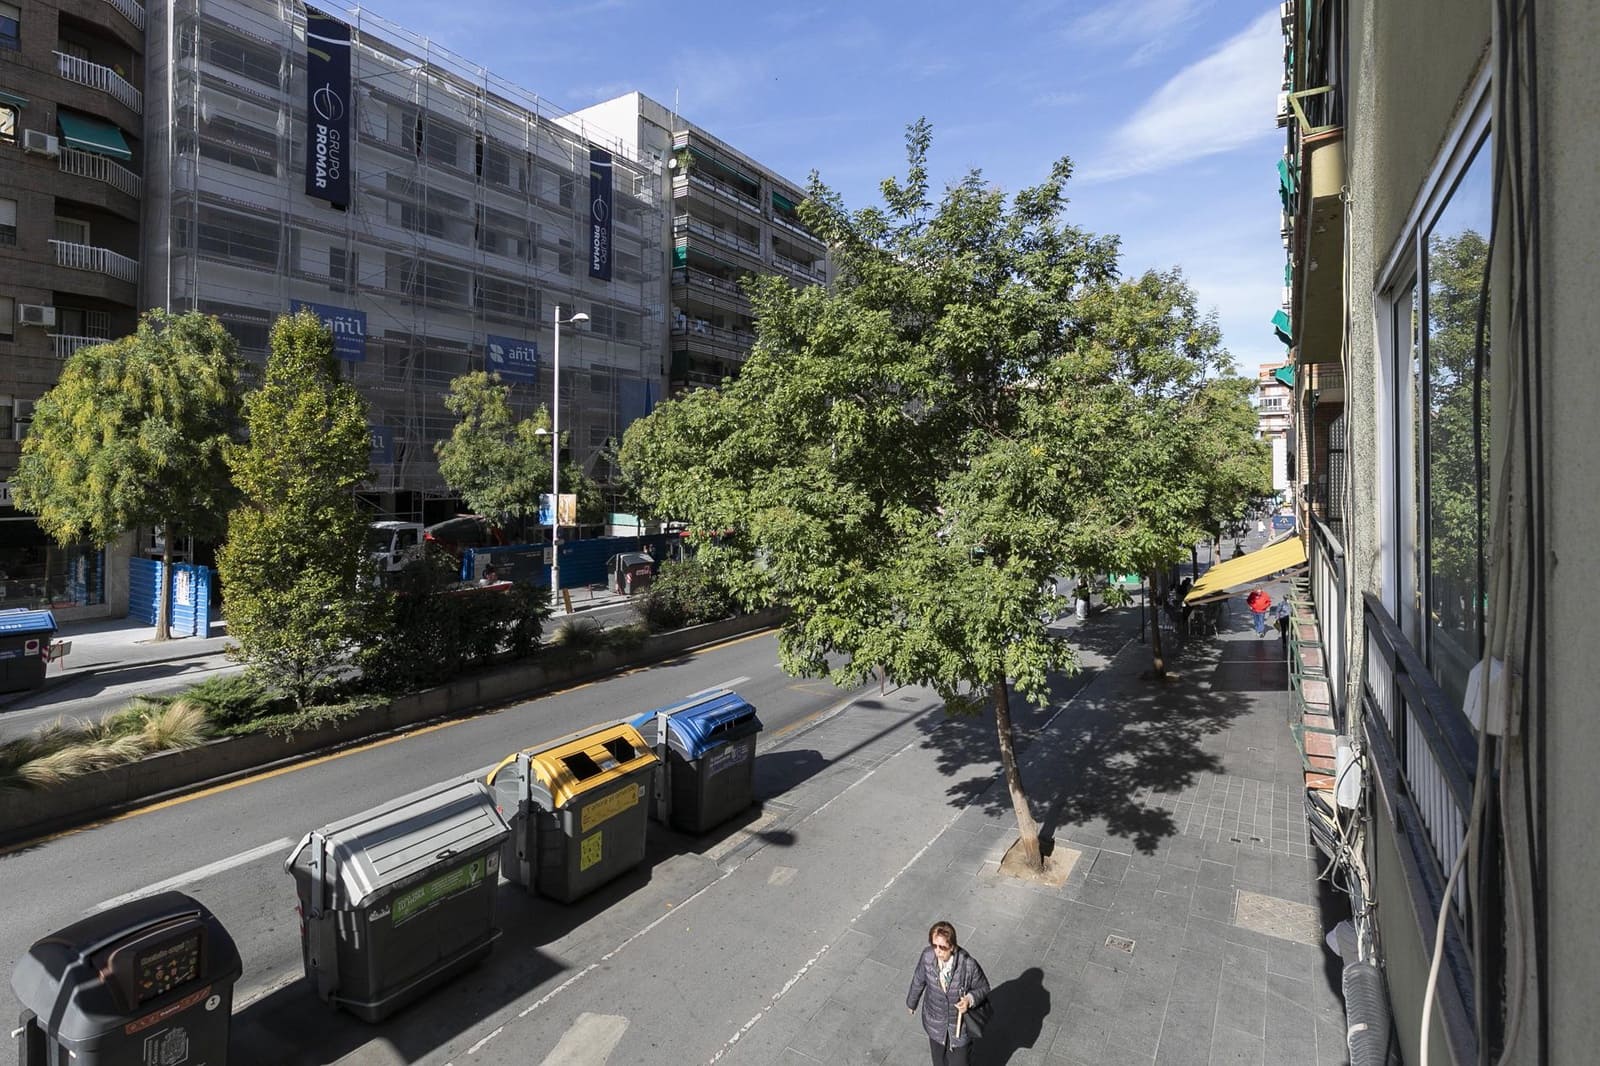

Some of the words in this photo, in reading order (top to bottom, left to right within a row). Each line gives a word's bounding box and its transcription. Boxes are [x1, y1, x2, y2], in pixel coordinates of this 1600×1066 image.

[316, 124, 328, 188] PROMAR
[329, 129, 340, 180] GRUPO
[508, 346, 537, 362] añil
